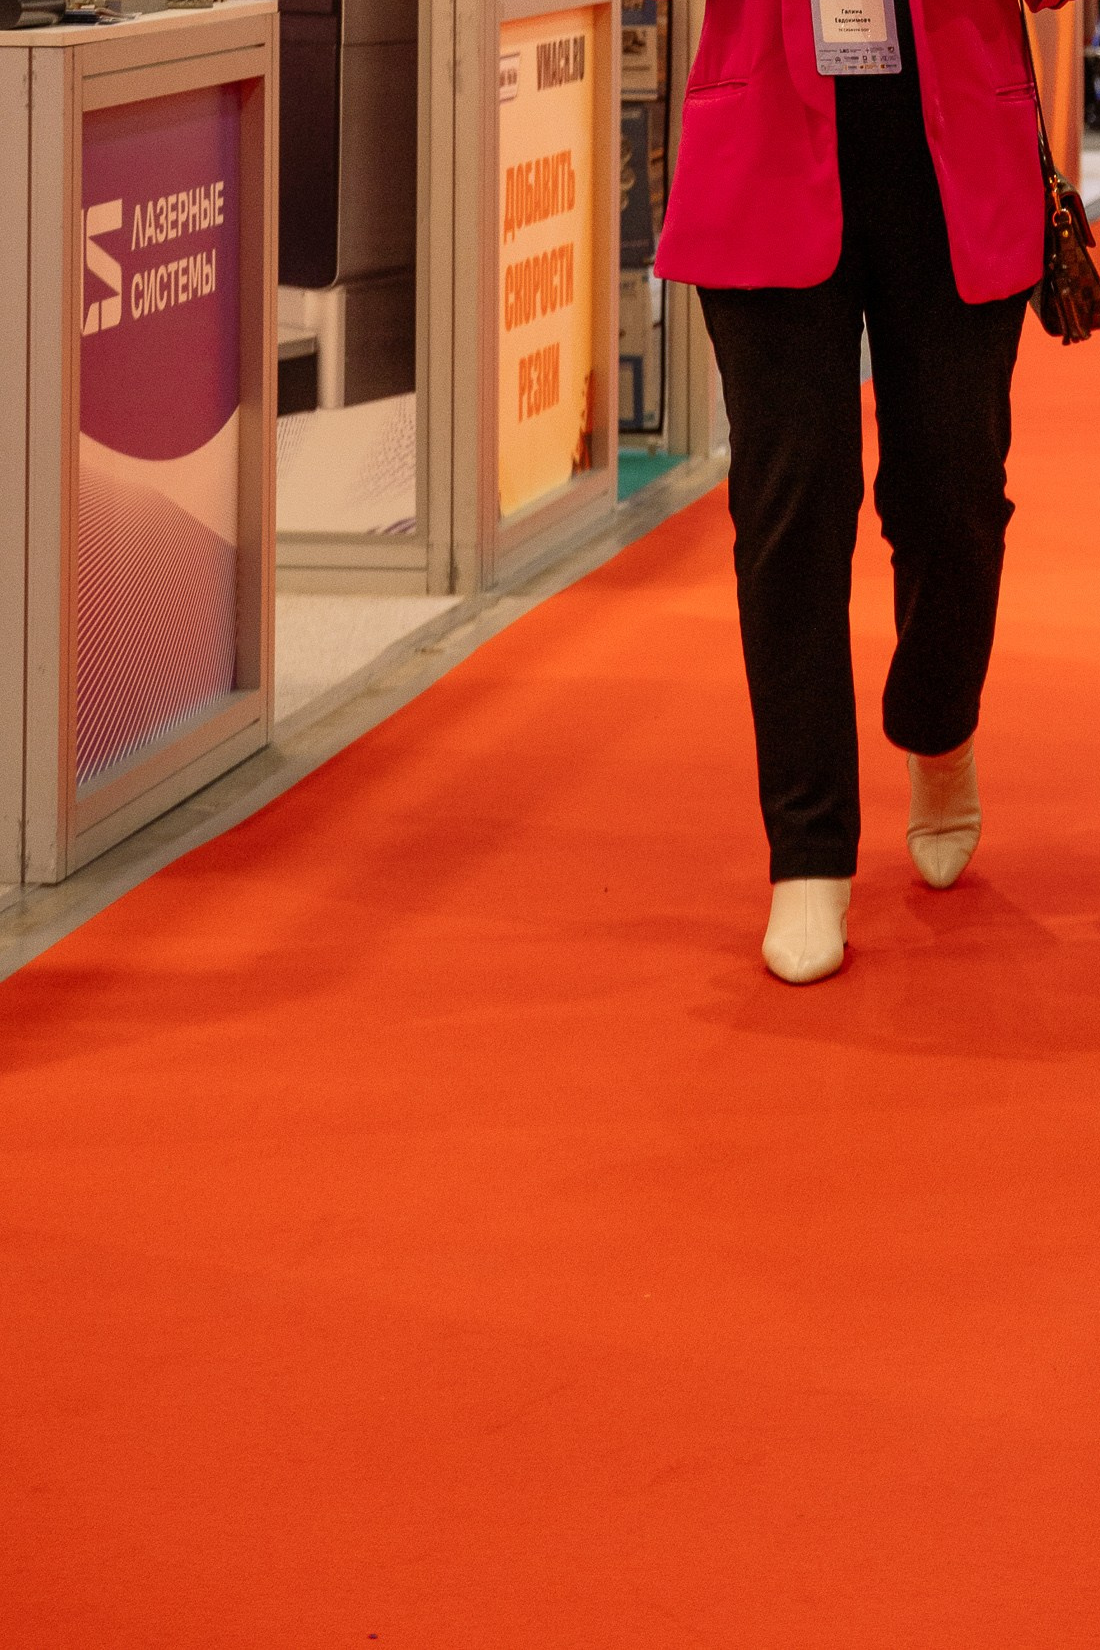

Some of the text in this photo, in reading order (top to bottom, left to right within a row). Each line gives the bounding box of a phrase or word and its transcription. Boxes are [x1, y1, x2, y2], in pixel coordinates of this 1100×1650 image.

[131, 181, 224, 251] ЛАЗЕРНЫЕ
[503, 147, 575, 246] ДОБАВИТЬ
[131, 249, 216, 320] СИСТЕМЫ
[504, 242, 574, 333] СКОРОСТИ
[518, 342, 561, 424] РЕЗКИ
